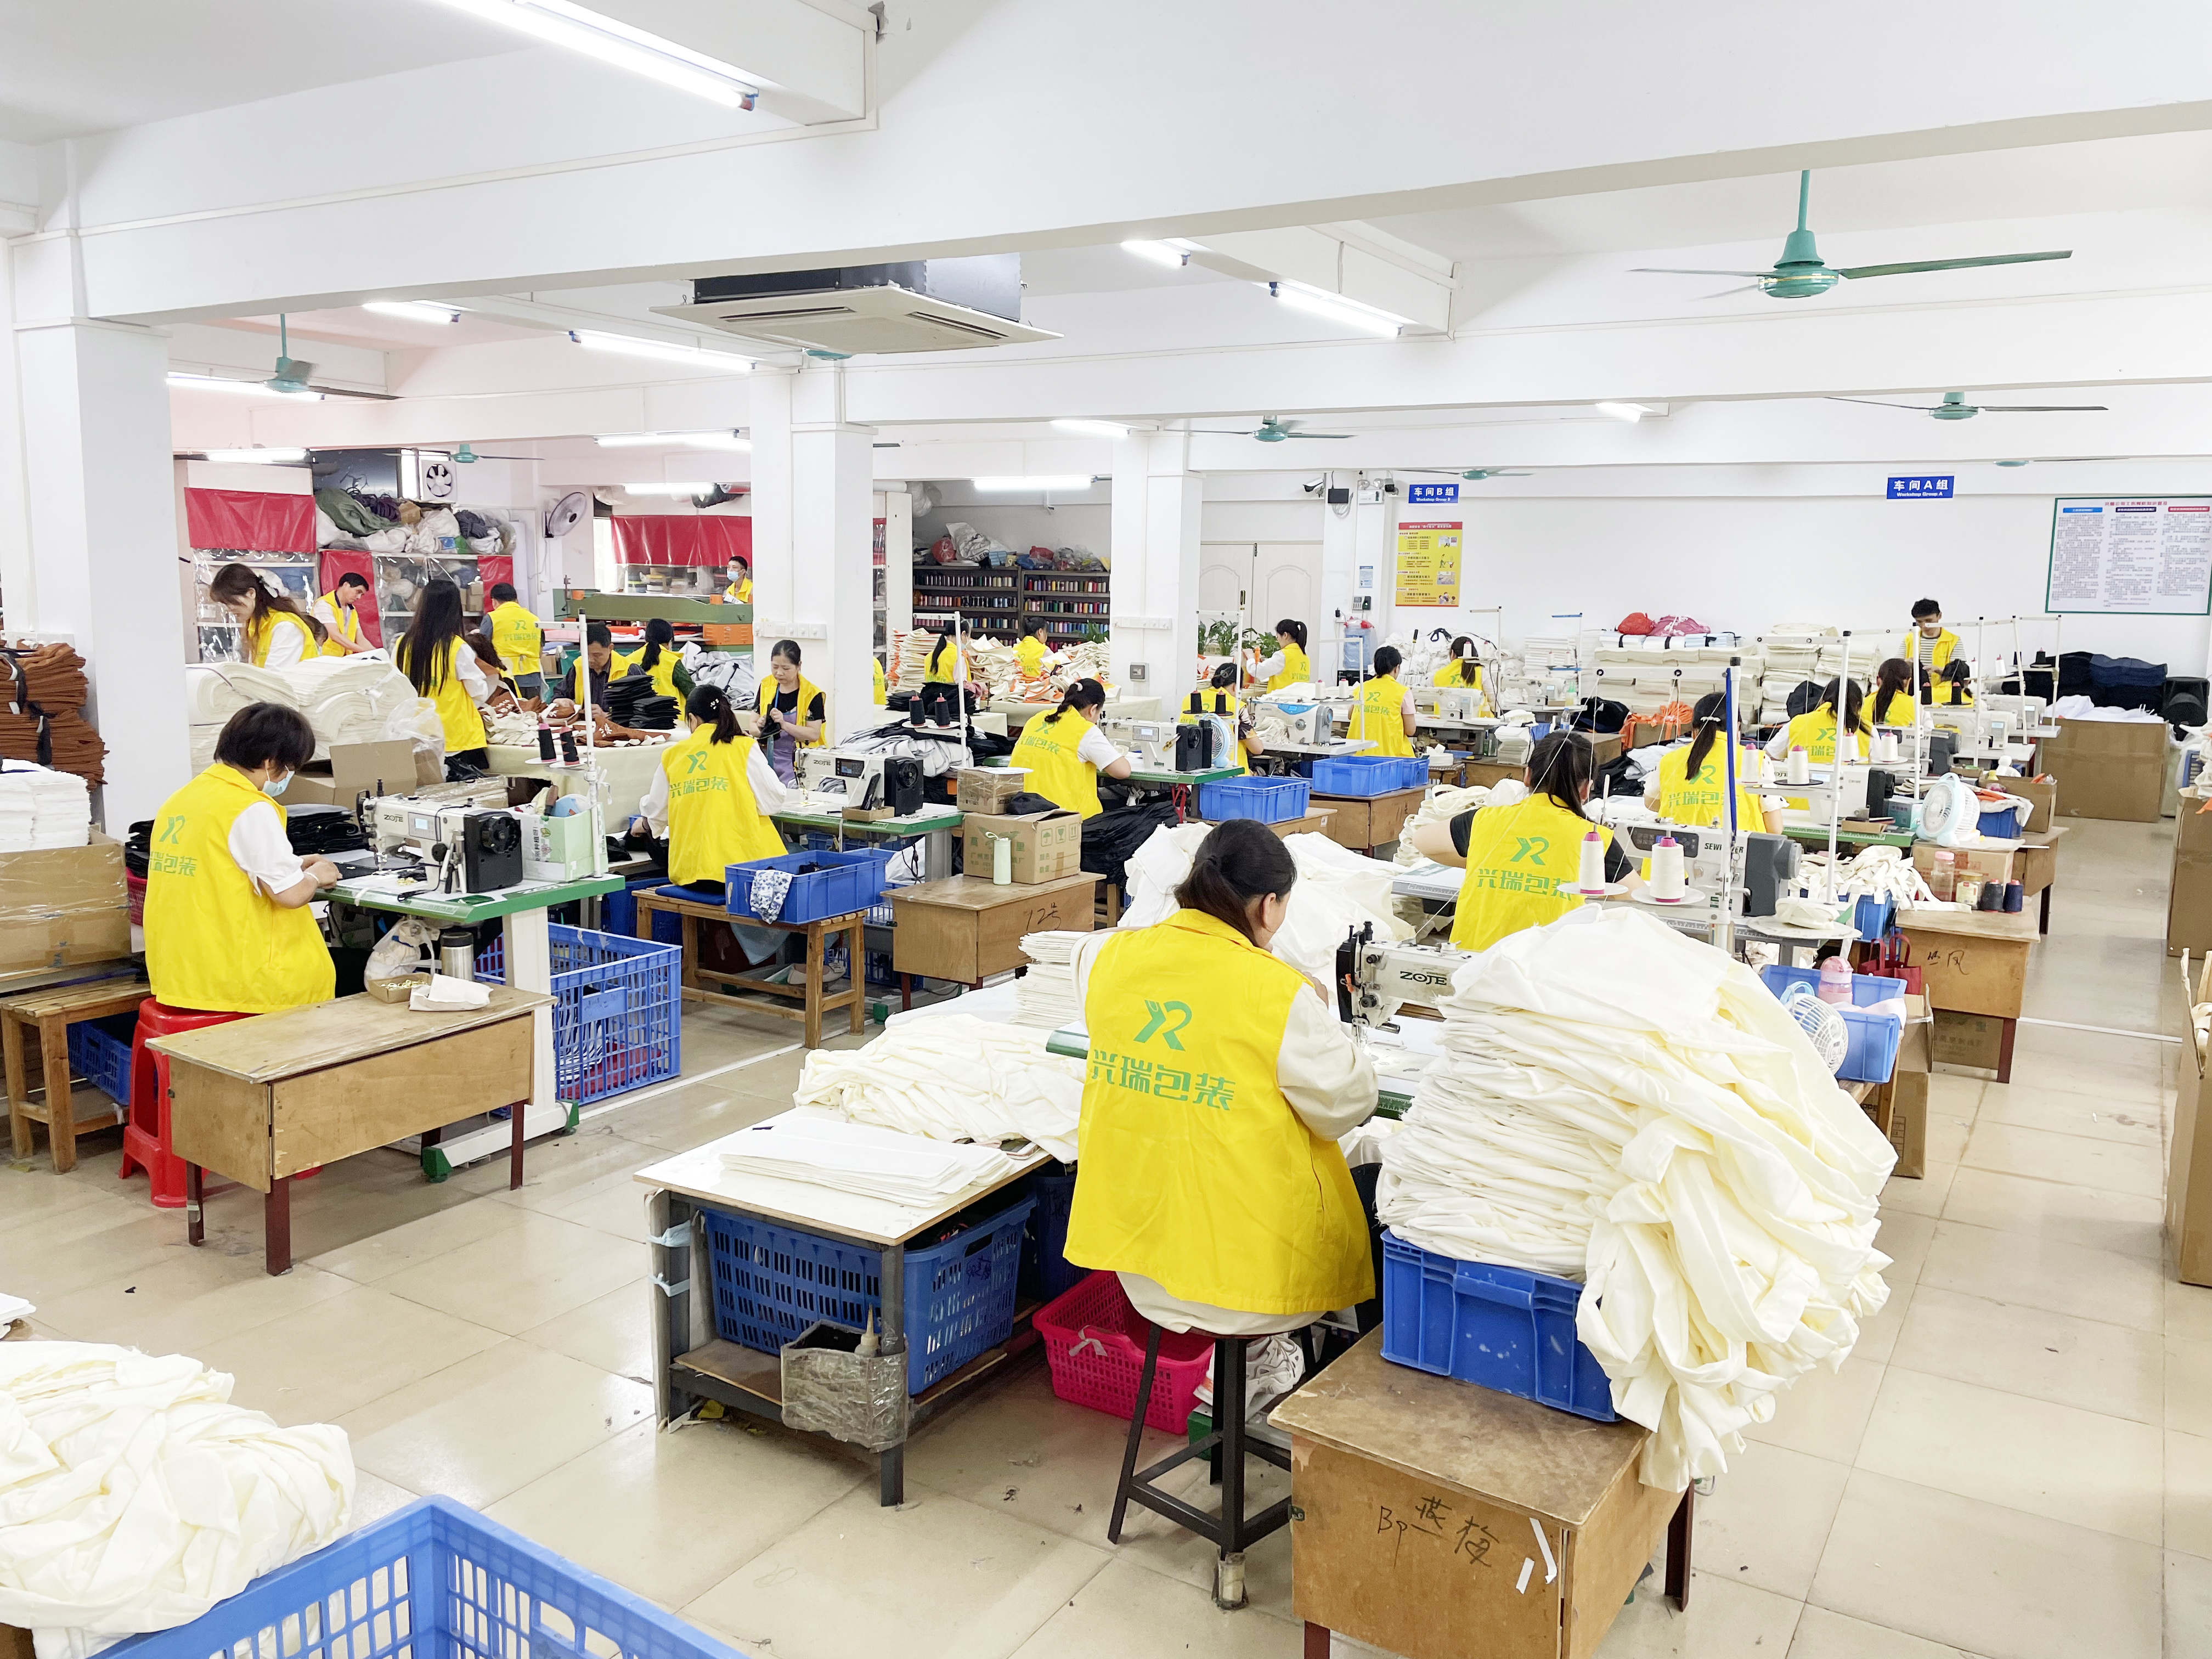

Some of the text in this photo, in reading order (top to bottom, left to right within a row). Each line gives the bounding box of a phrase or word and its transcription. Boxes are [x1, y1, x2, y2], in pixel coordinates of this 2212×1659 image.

[1414, 487, 1454, 496] 车间B组
[1893, 479, 1948, 491] 车间A组
[669, 776, 729, 799] 兴瑞包装
[383, 814, 403, 822] ZOJE
[1400, 970, 1447, 985] ZOJE
[1092, 1049, 1235, 1110] 兴瑞包装
